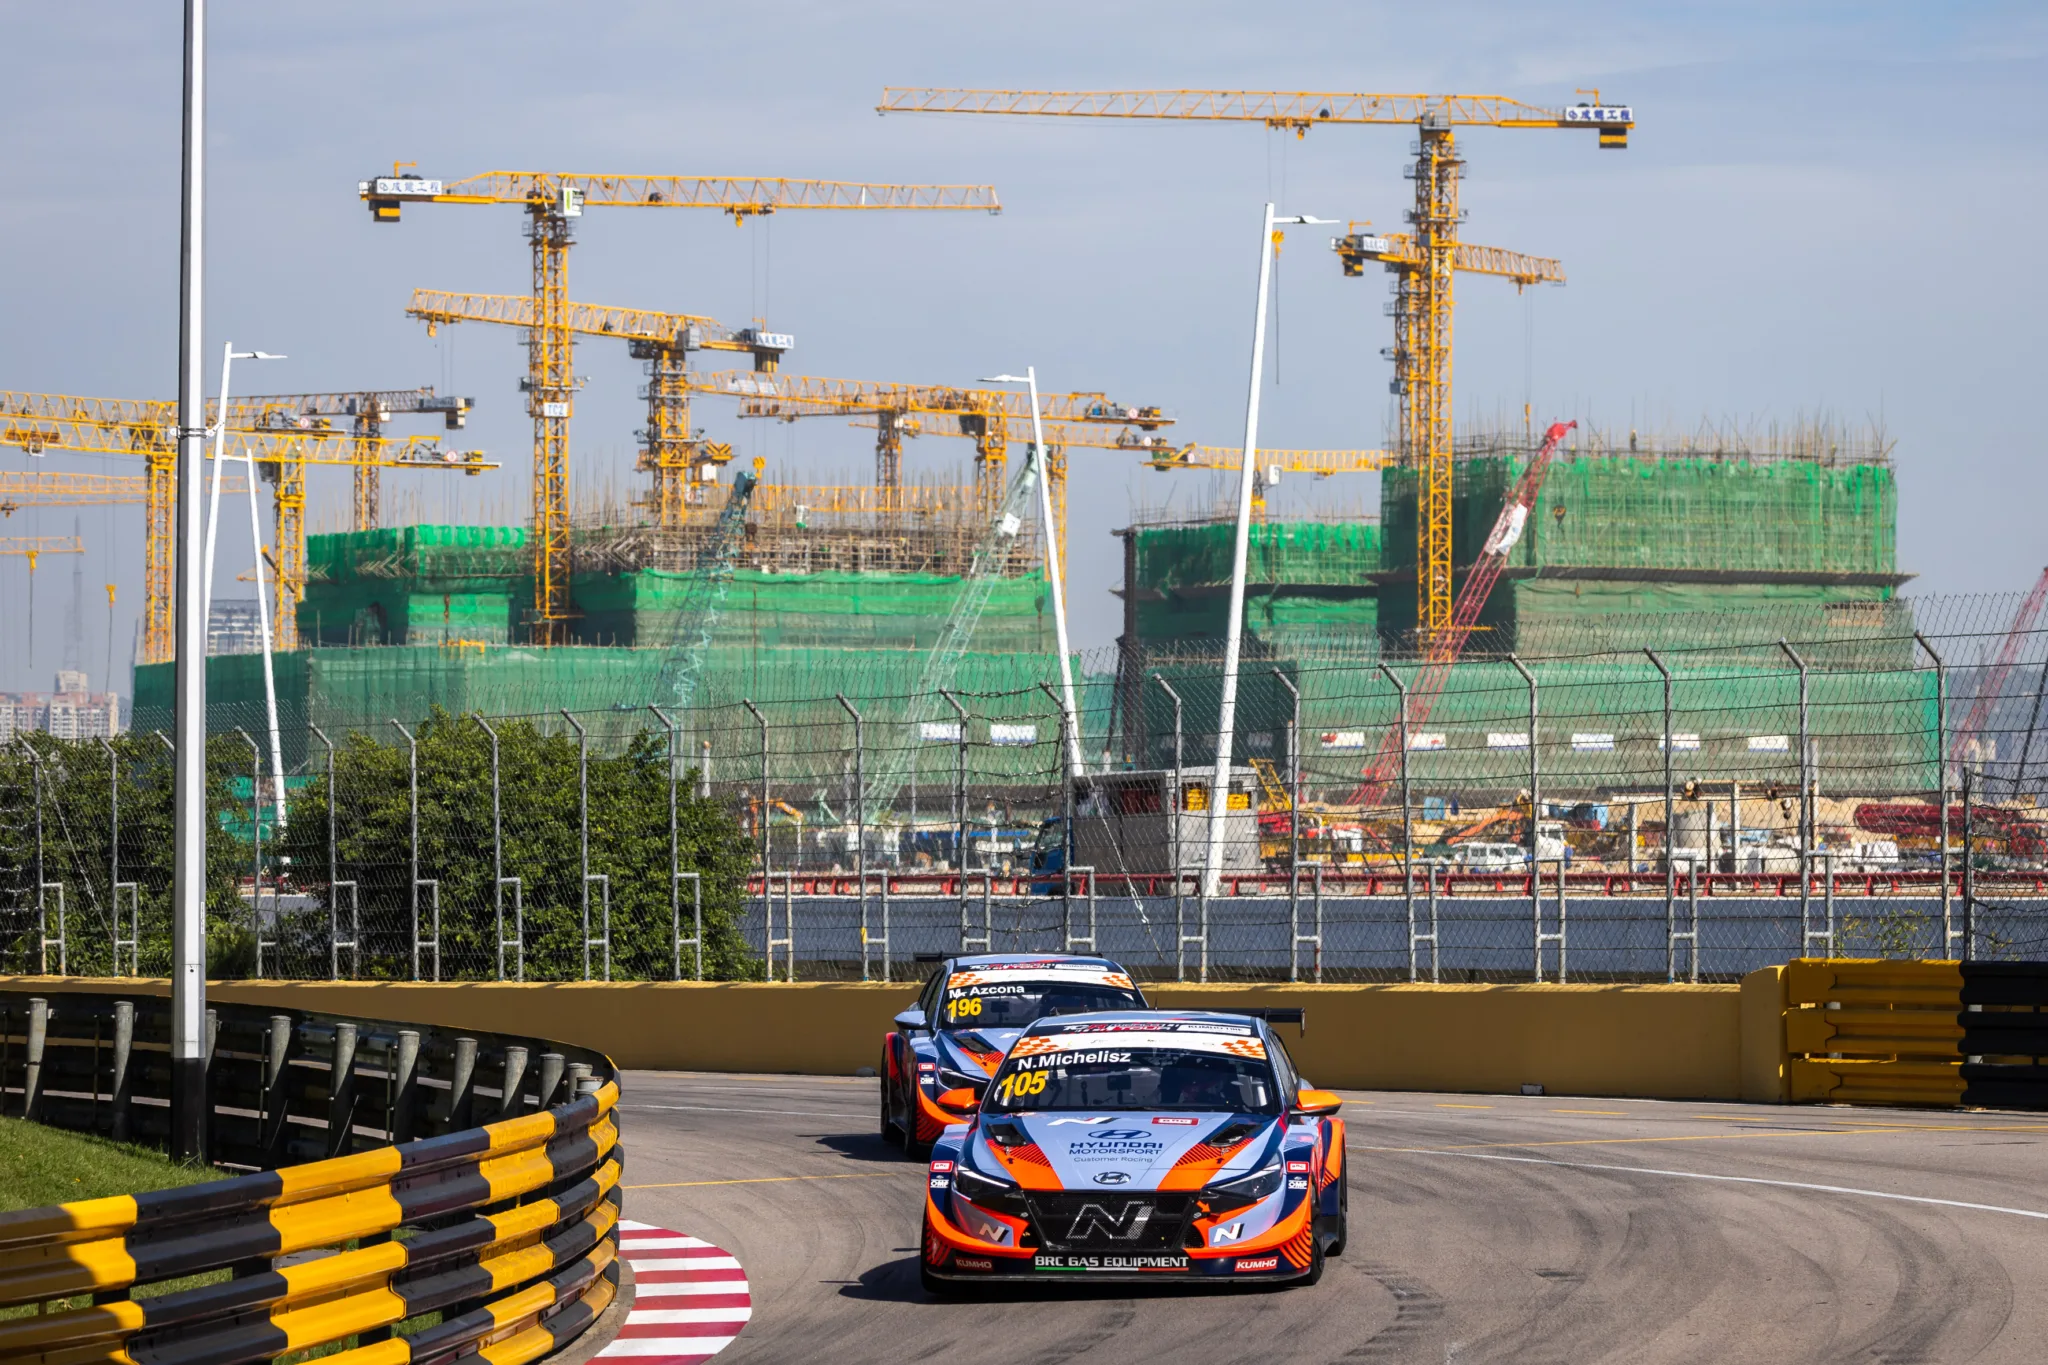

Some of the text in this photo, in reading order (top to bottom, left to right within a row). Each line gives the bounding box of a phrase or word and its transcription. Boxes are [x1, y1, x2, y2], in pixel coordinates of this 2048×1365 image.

[969, 986, 1025, 996] Azcona
[947, 997, 982, 1018] 196
[1017, 1050, 1132, 1071] N.Michelisz
[1001, 1070, 1049, 1099] 105
[1070, 1141, 1164, 1149] HYUNDAI
[1120, 1156, 1153, 1164] Racing
[956, 1258, 993, 1269] KUMHO
[1034, 1256, 1189, 1268] BRC GAS EQUIPMENT
[1236, 1258, 1277, 1270] KUMHO
